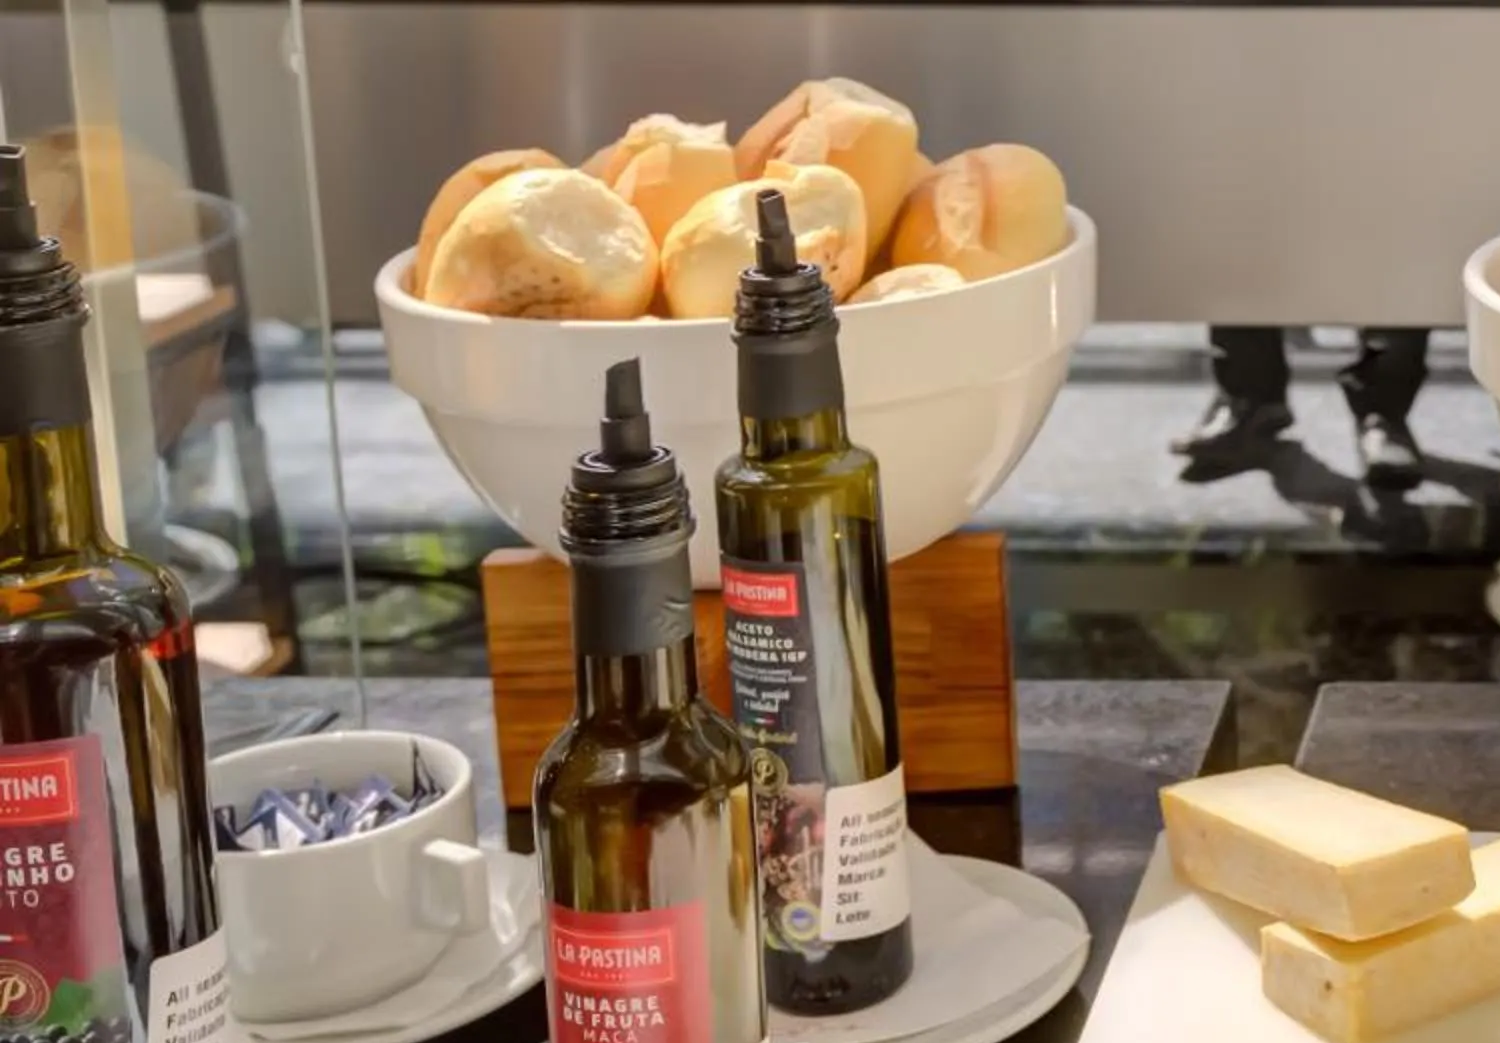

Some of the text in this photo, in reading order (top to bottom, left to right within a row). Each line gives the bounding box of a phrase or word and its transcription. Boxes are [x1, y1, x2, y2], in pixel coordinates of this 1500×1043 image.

[736, 621, 773, 636] ACETO
[0, 842, 67, 866] GRE
[0, 863, 75, 887] NHO
[557, 937, 661, 969] LA PASTINA
[166, 984, 190, 1007] All
[565, 991, 660, 1013] VINAGRE
[563, 1005, 665, 1030] DE FRUTA
